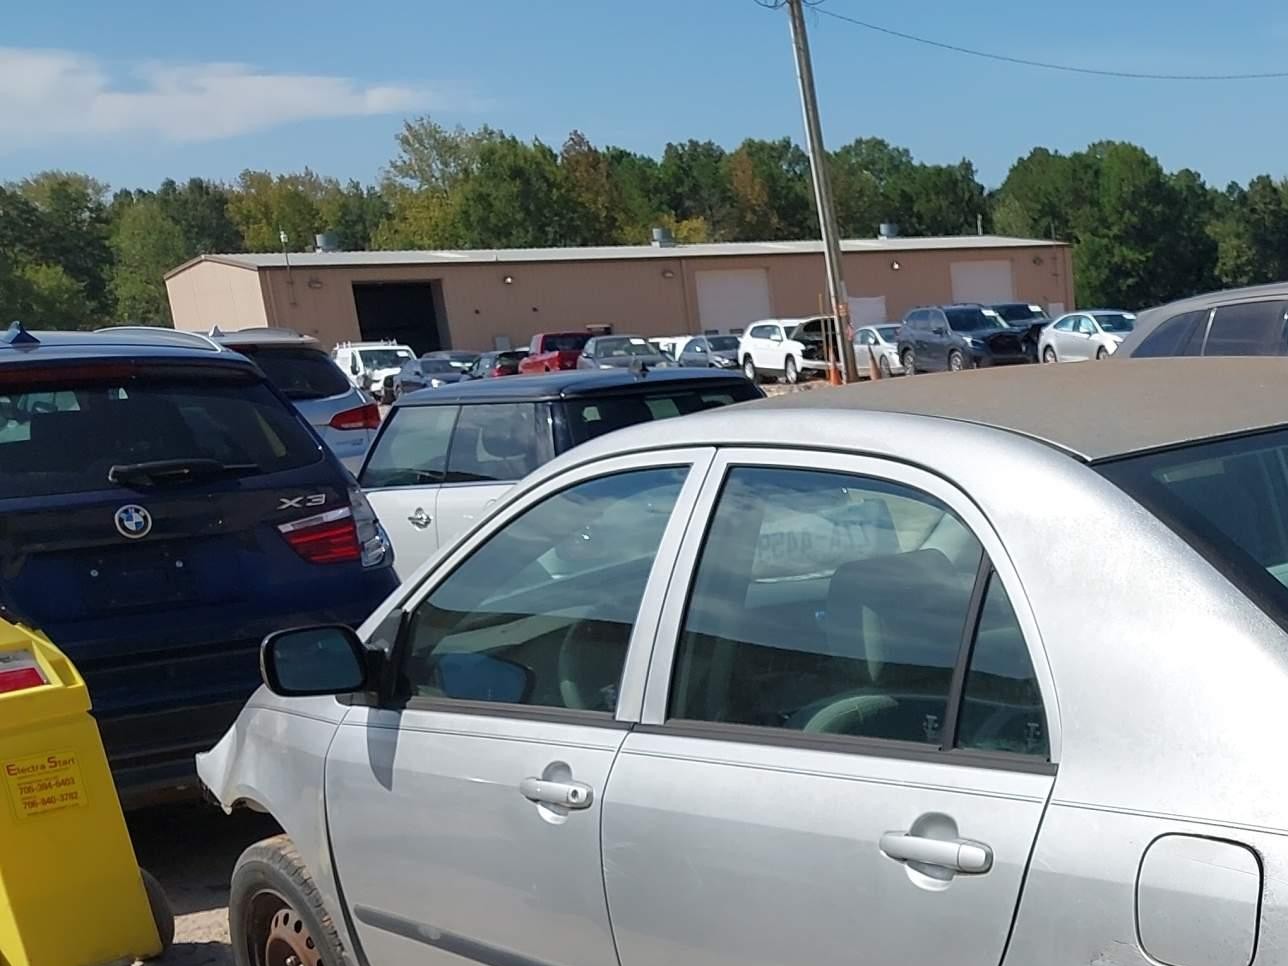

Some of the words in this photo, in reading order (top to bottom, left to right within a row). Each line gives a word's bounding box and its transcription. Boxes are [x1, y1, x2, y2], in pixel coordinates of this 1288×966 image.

[276, 494, 326, 509] X3
[6, 763, 46, 777] Electra
[47, 756, 76, 769] Start
